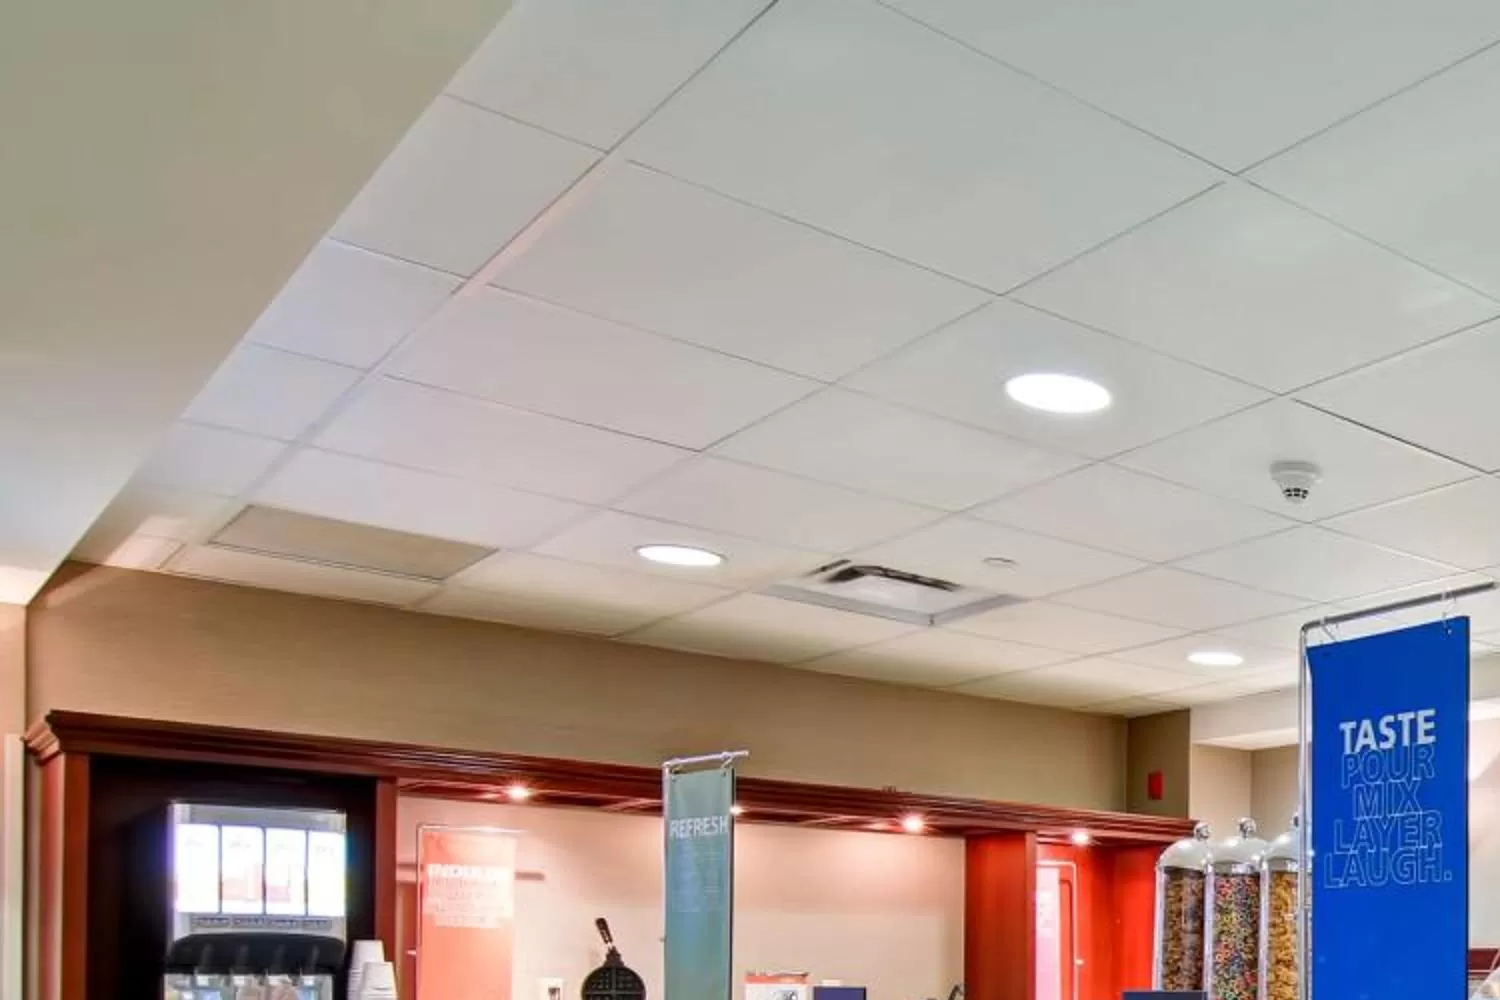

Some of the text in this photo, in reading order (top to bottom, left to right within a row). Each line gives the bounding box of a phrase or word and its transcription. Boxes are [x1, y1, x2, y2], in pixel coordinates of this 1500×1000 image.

[1339, 708, 1437, 755] TASTE
[1341, 744, 1435, 789] POUR
[1353, 780, 1423, 821] MIX
[670, 815, 728, 840] REFRESH
[1333, 809, 1443, 855] LAYER
[1323, 846, 1453, 889] LAUGH.
